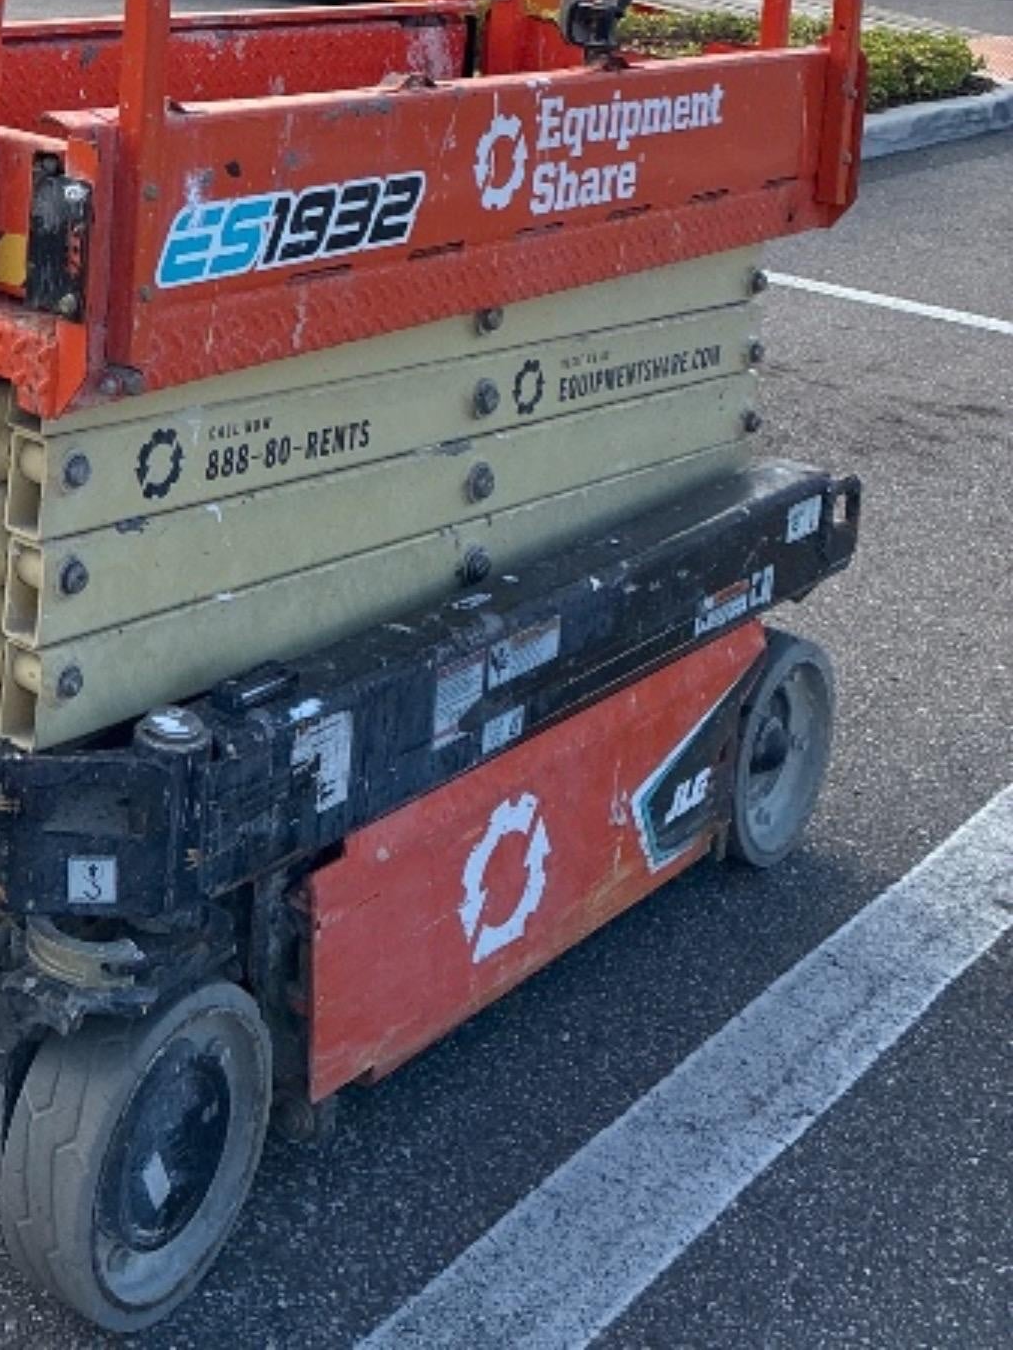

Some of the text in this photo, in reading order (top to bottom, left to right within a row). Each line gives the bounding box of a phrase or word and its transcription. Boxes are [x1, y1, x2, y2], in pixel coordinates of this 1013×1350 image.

[535, 82, 725, 157] Equipment
[529, 160, 637, 216] Share
[156, 170, 426, 289] ES1932
[205, 418, 372, 481] 888-80-RENTS
[664, 766, 711, 825] JLG
